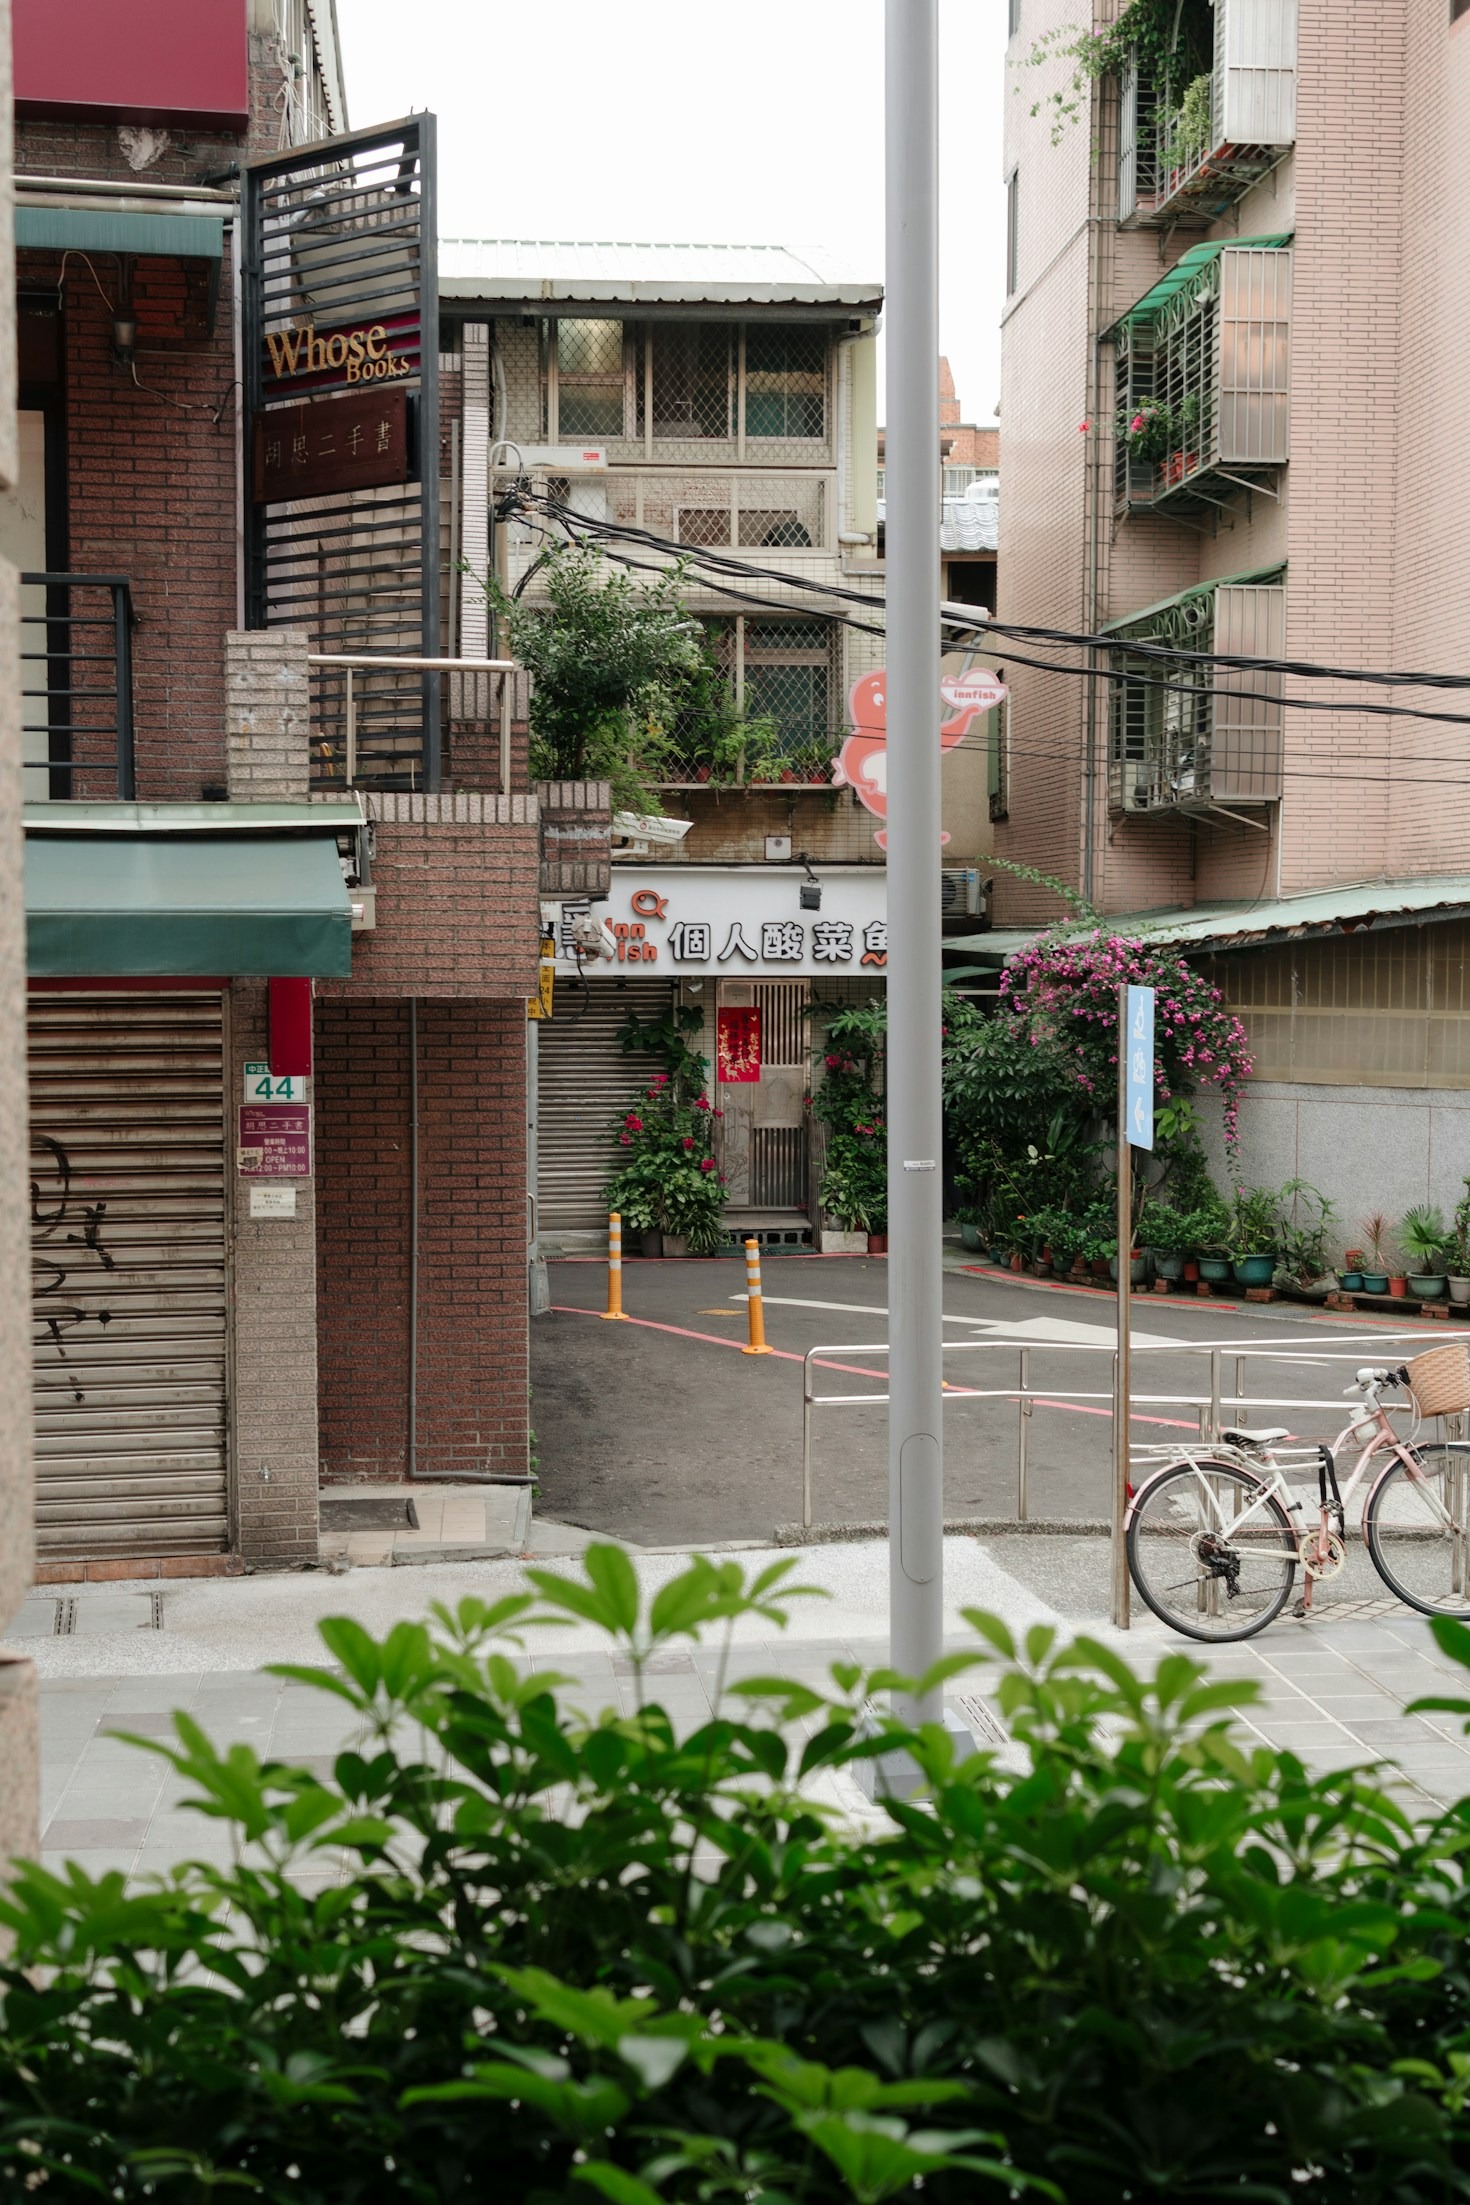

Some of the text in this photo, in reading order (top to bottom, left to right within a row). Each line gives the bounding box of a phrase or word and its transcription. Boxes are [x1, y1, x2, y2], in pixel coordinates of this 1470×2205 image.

[264, 324, 388, 379] Whose
[346, 351, 411, 384] Books
[265, 420, 392, 468] 胡思二手書
[954, 690, 996, 699] innfish
[606, 940, 658, 961] ish
[255, 1076, 294, 1099] 44
